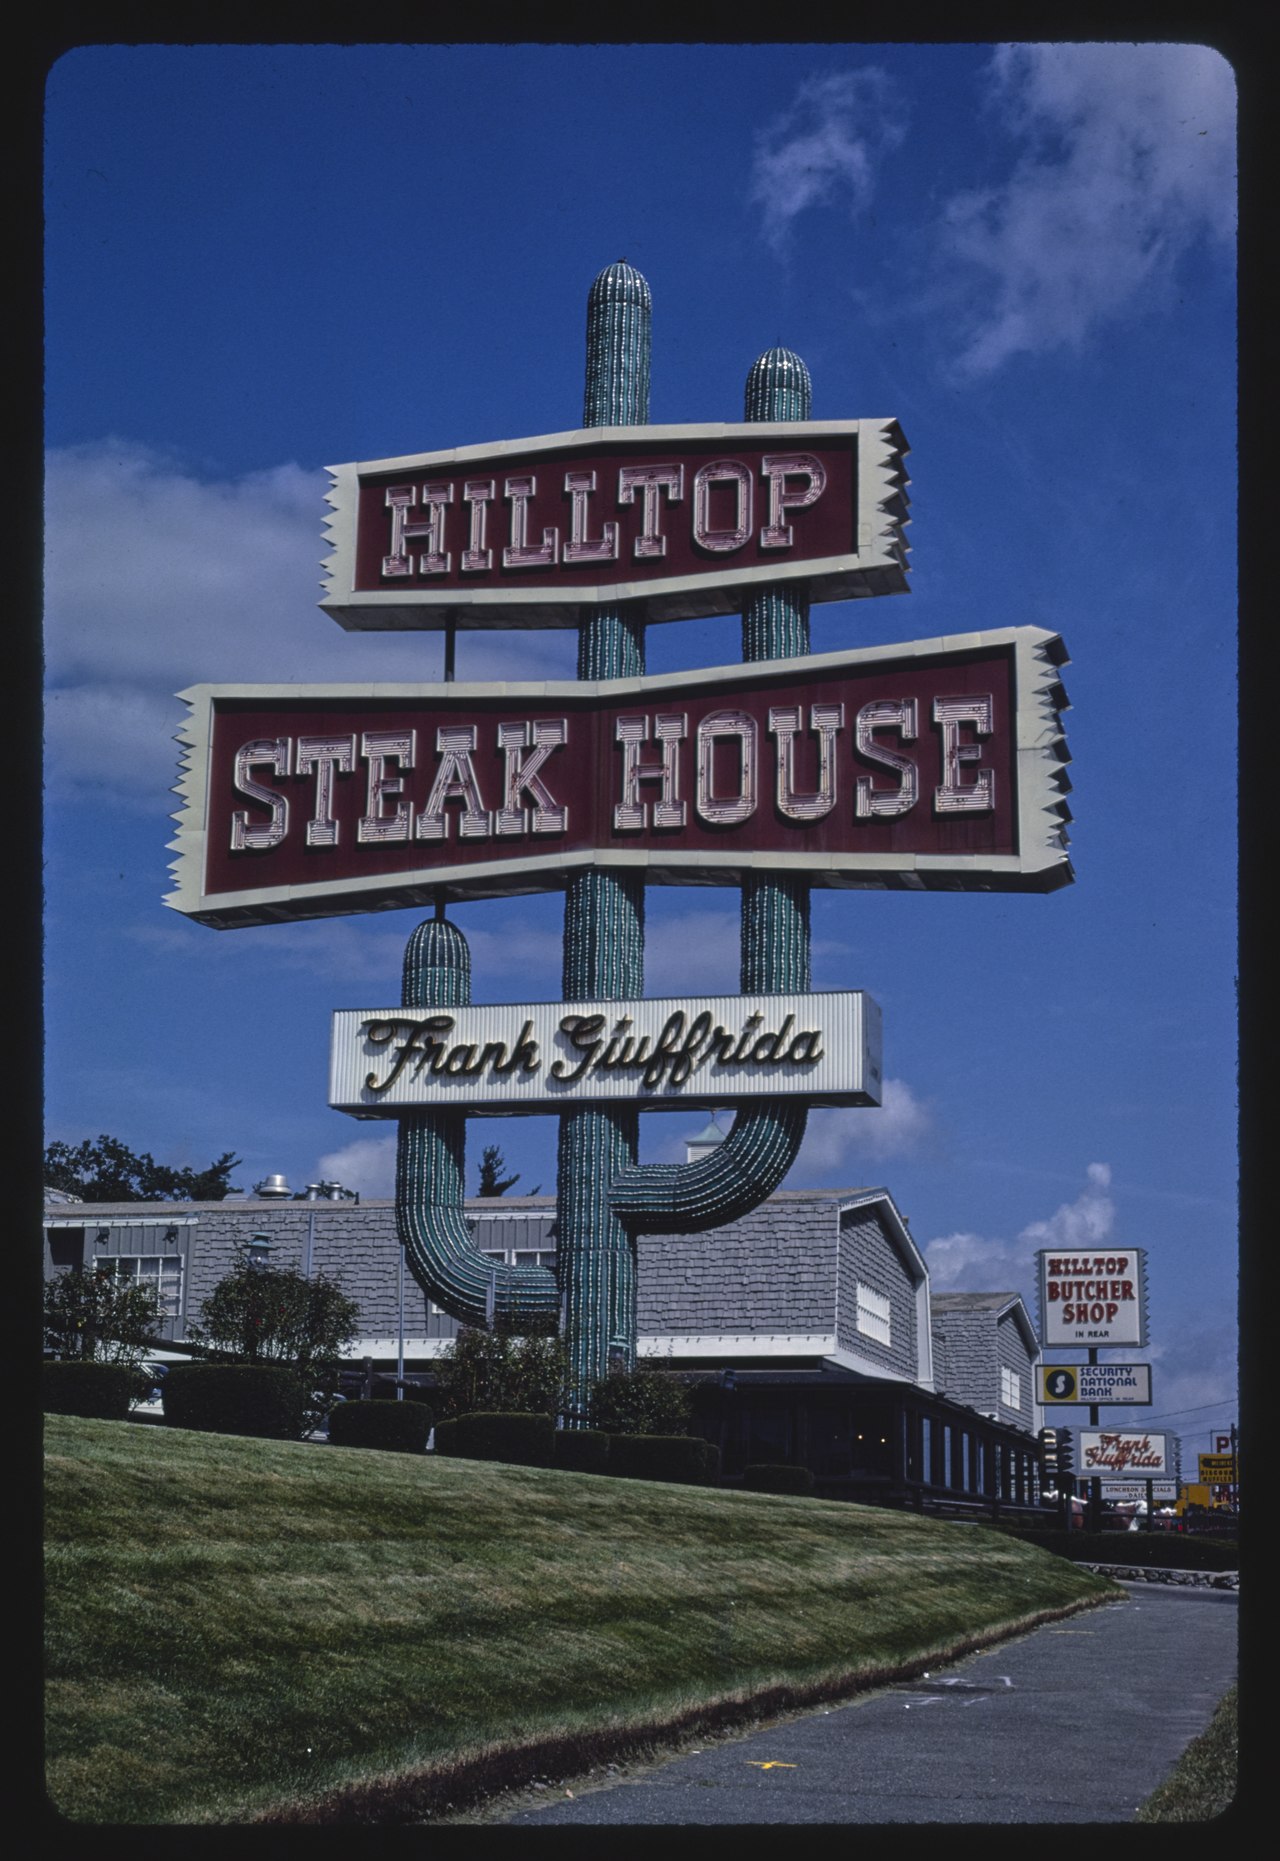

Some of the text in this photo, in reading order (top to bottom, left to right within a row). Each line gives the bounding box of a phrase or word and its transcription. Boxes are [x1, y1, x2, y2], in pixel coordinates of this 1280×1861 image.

[381, 452, 827, 578] HILLTOP
[230, 692, 996, 852] STEAK HOUSE
[361, 1009, 825, 1093] Frank Giuffrida
[1048, 1257, 1129, 1277] HILLTOP
[1047, 1280, 1136, 1302] BUTCHER
[1062, 1302, 1119, 1325] SHOP
[1080, 1367, 1133, 1377] SECURITY
[1080, 1377, 1137, 1386] NATIONAL
[1080, 1387, 1112, 1397] BANK
